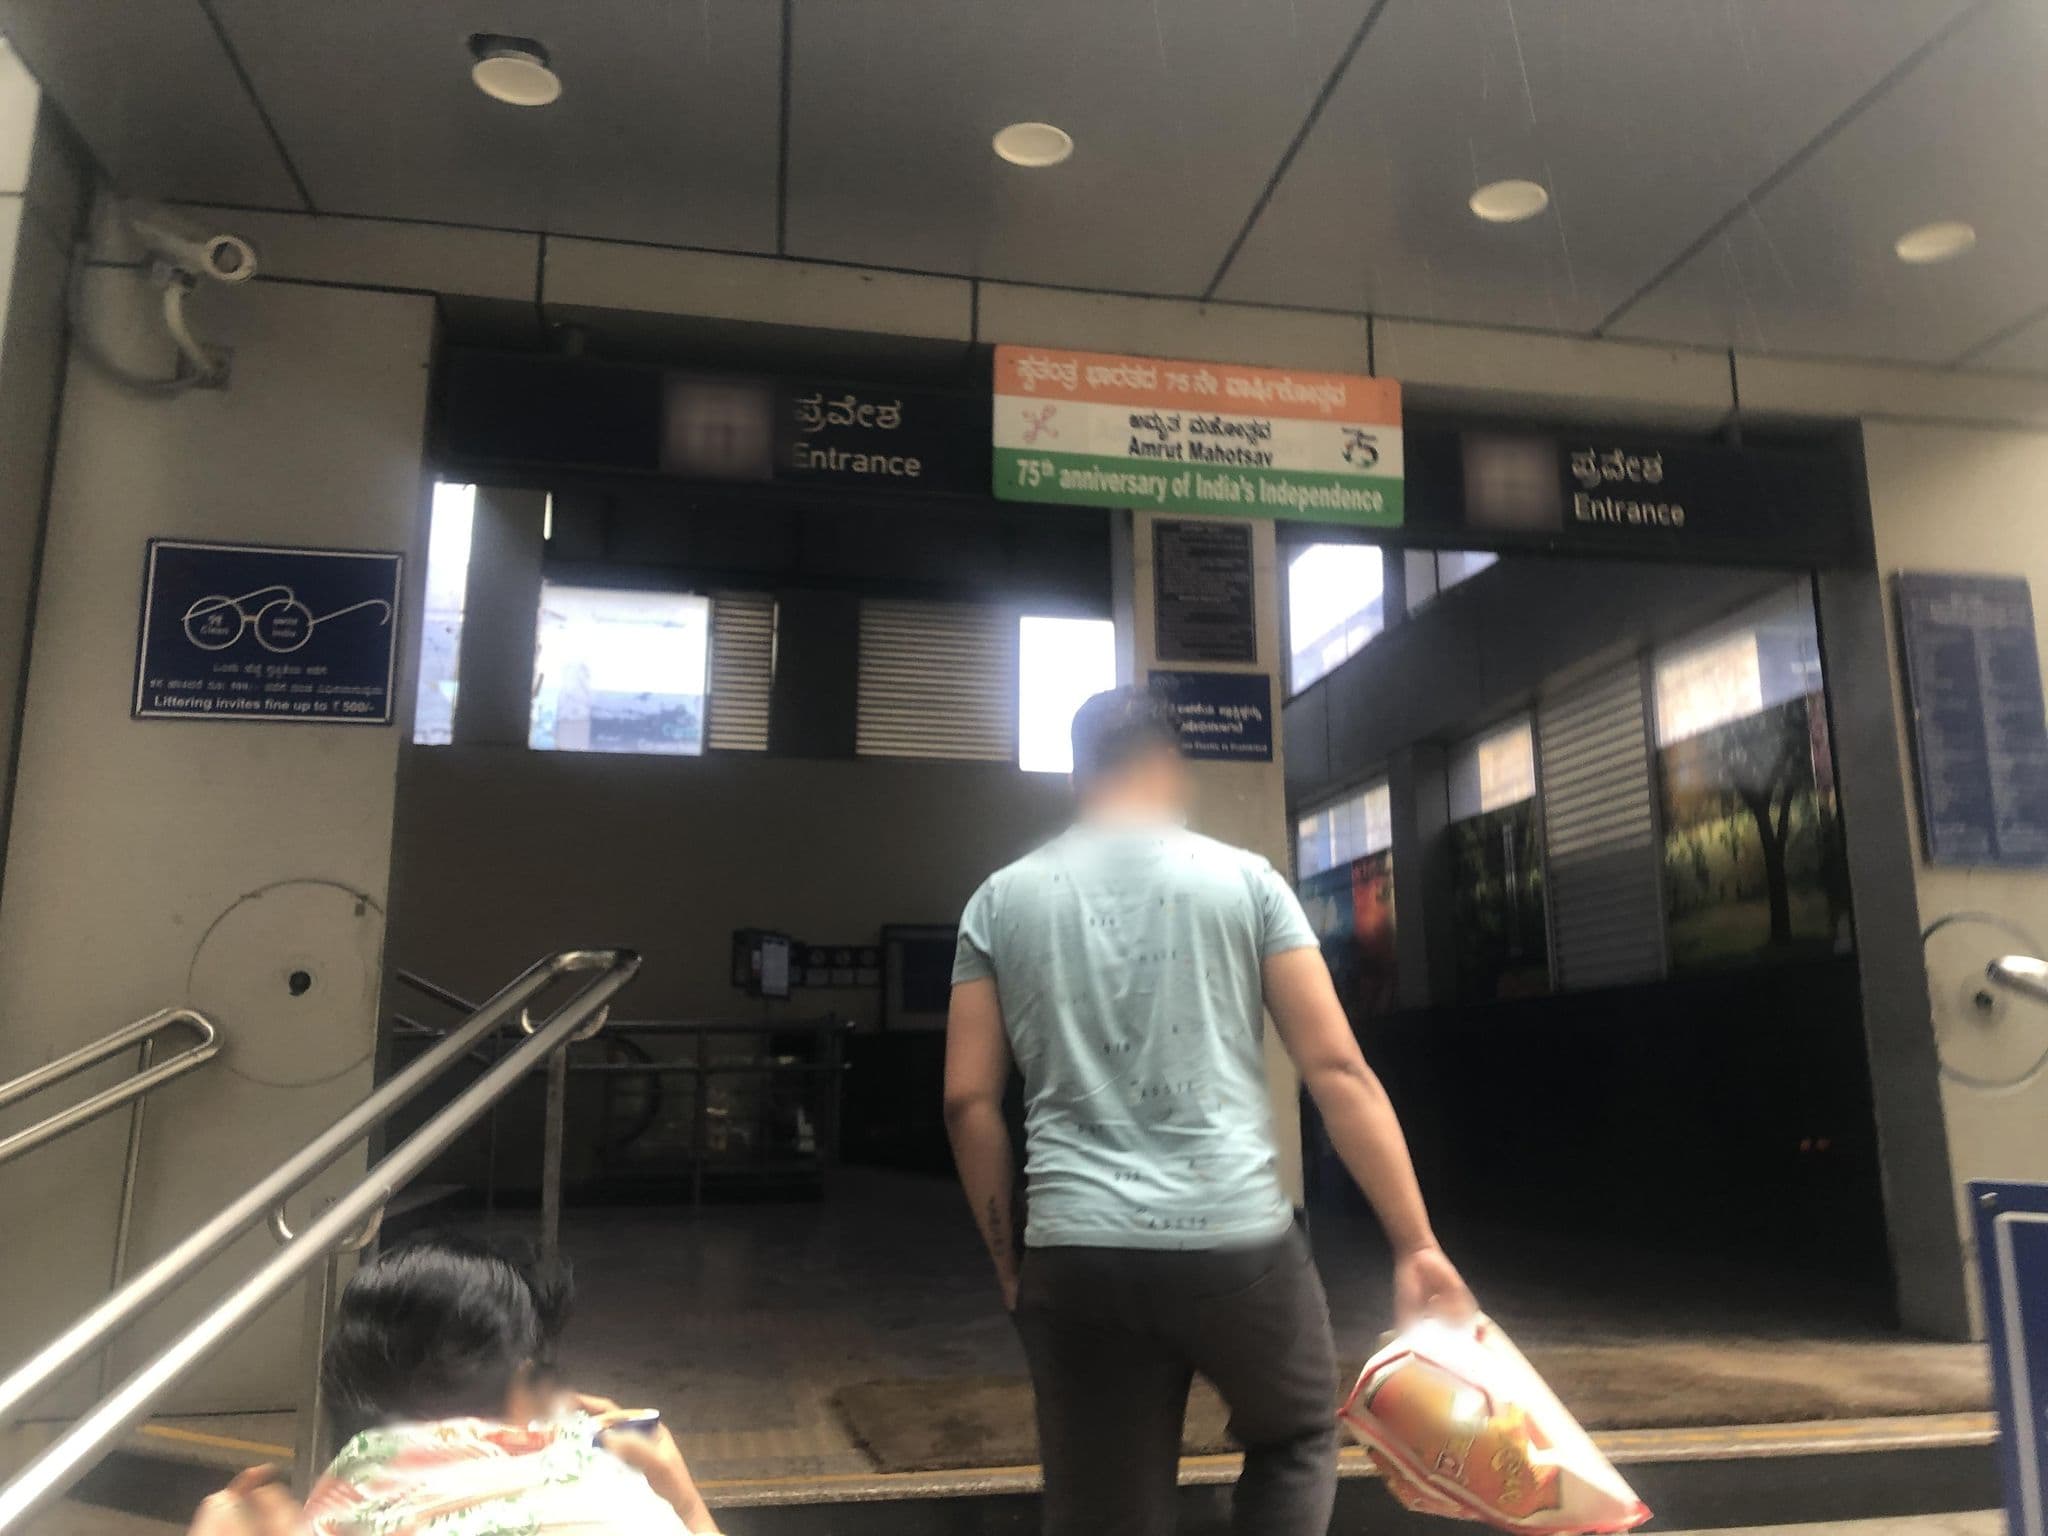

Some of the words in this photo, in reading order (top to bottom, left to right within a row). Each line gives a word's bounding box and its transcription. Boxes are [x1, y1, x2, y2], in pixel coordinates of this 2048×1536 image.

[1164, 371, 1190, 393] 75
[793, 441, 921, 477] Entrance
[1128, 435, 1184, 461] Amrut
[1188, 440, 1273, 467] Mahotsav
[1016, 458, 1055, 487] 75th
[1059, 464, 1168, 503] anniversary
[1172, 471, 1191, 498] of
[1195, 472, 1256, 503] India's
[1259, 476, 1383, 512] Independence
[1573, 492, 1685, 527] Entrance
[154, 695, 212, 711] Littering
[216, 696, 261, 710] invites
[264, 698, 289, 711] fine
[293, 701, 311, 713] up
[314, 701, 328, 711] to
